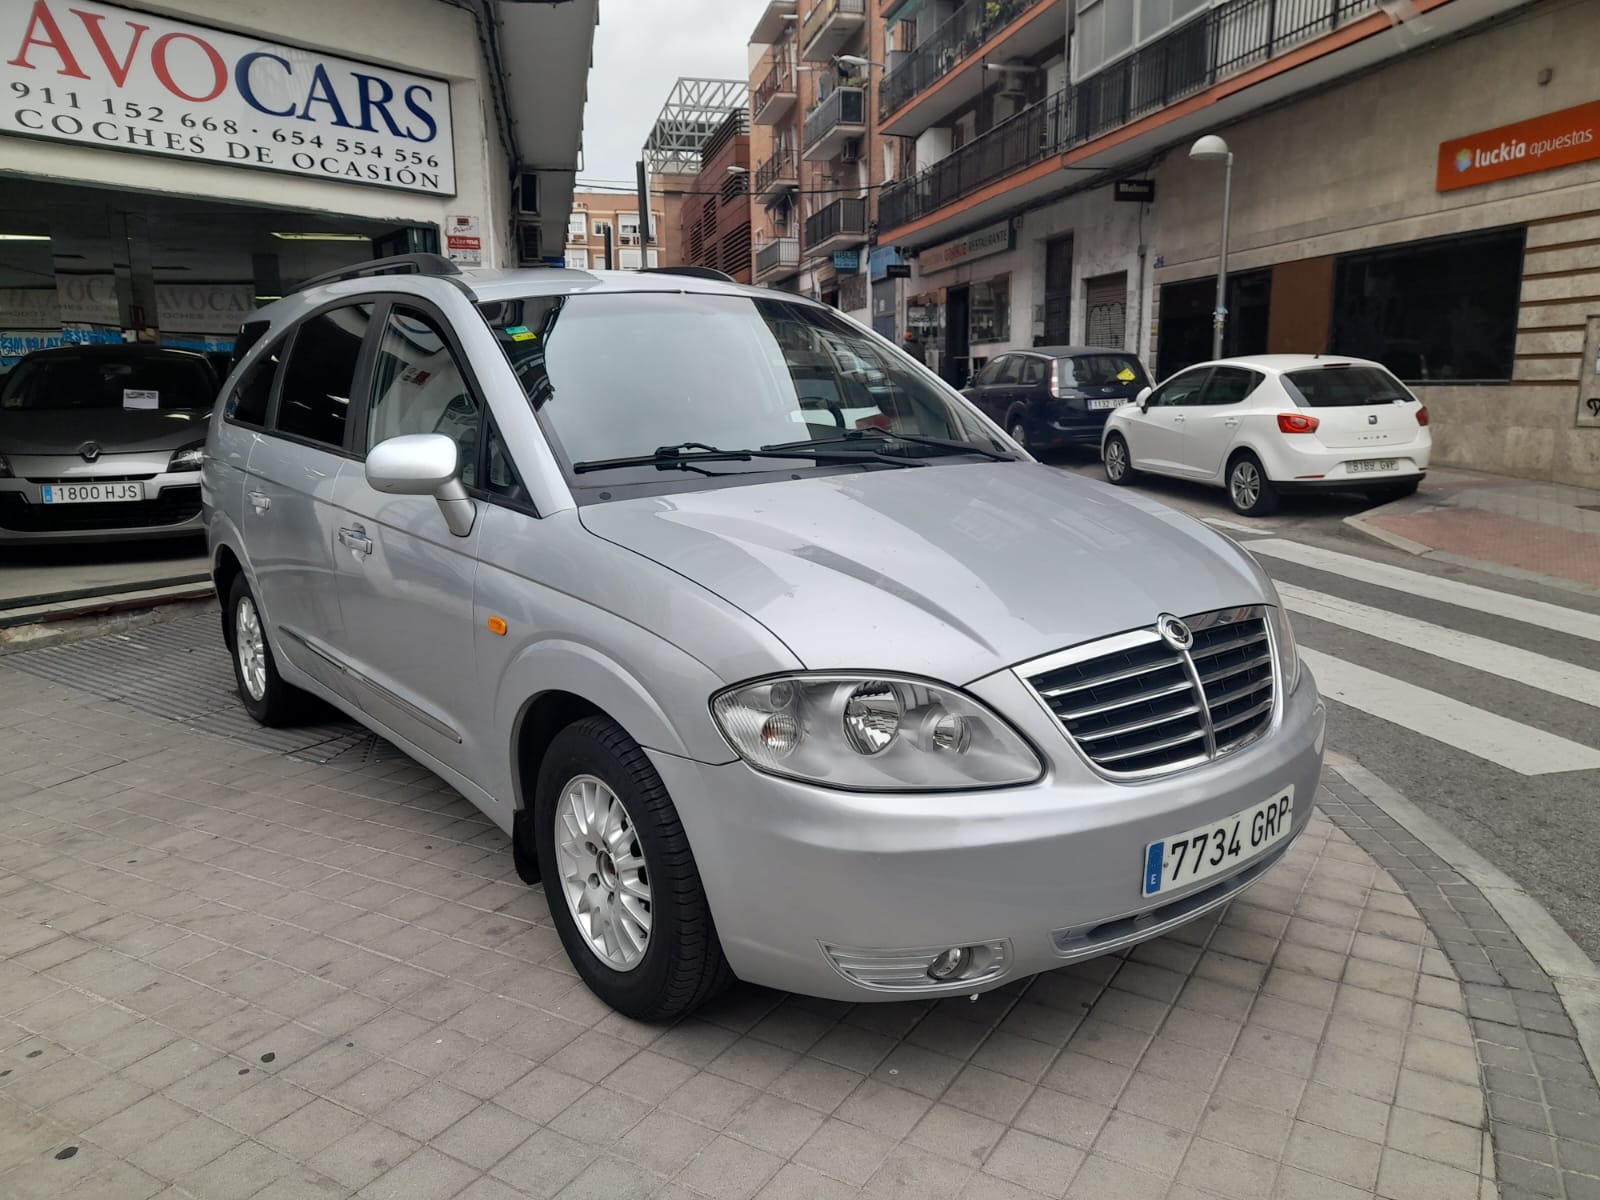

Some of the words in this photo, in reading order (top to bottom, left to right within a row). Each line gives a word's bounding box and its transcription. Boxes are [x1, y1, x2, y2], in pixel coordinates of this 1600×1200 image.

[7, 0, 438, 144] AVOCARS
[10, 81, 81, 109] 911
[102, 97, 165, 123] 152
[180, 112, 239, 135] 668
[271, 127, 324, 149] 654
[335, 138, 384, 160] 554
[394, 148, 439, 169] 556
[13, 108, 206, 155] COCHES
[227, 141, 274, 164] DE
[291, 151, 440, 190] OCASIÓN
[1475, 140, 1526, 167] luckia
[1529, 128, 1593, 157] apuestas
[58, 486, 100, 501] 1800
[105, 485, 138, 500] HJS
[1171, 821, 1241, 881] 7734
[1250, 795, 1289, 848] GRP
